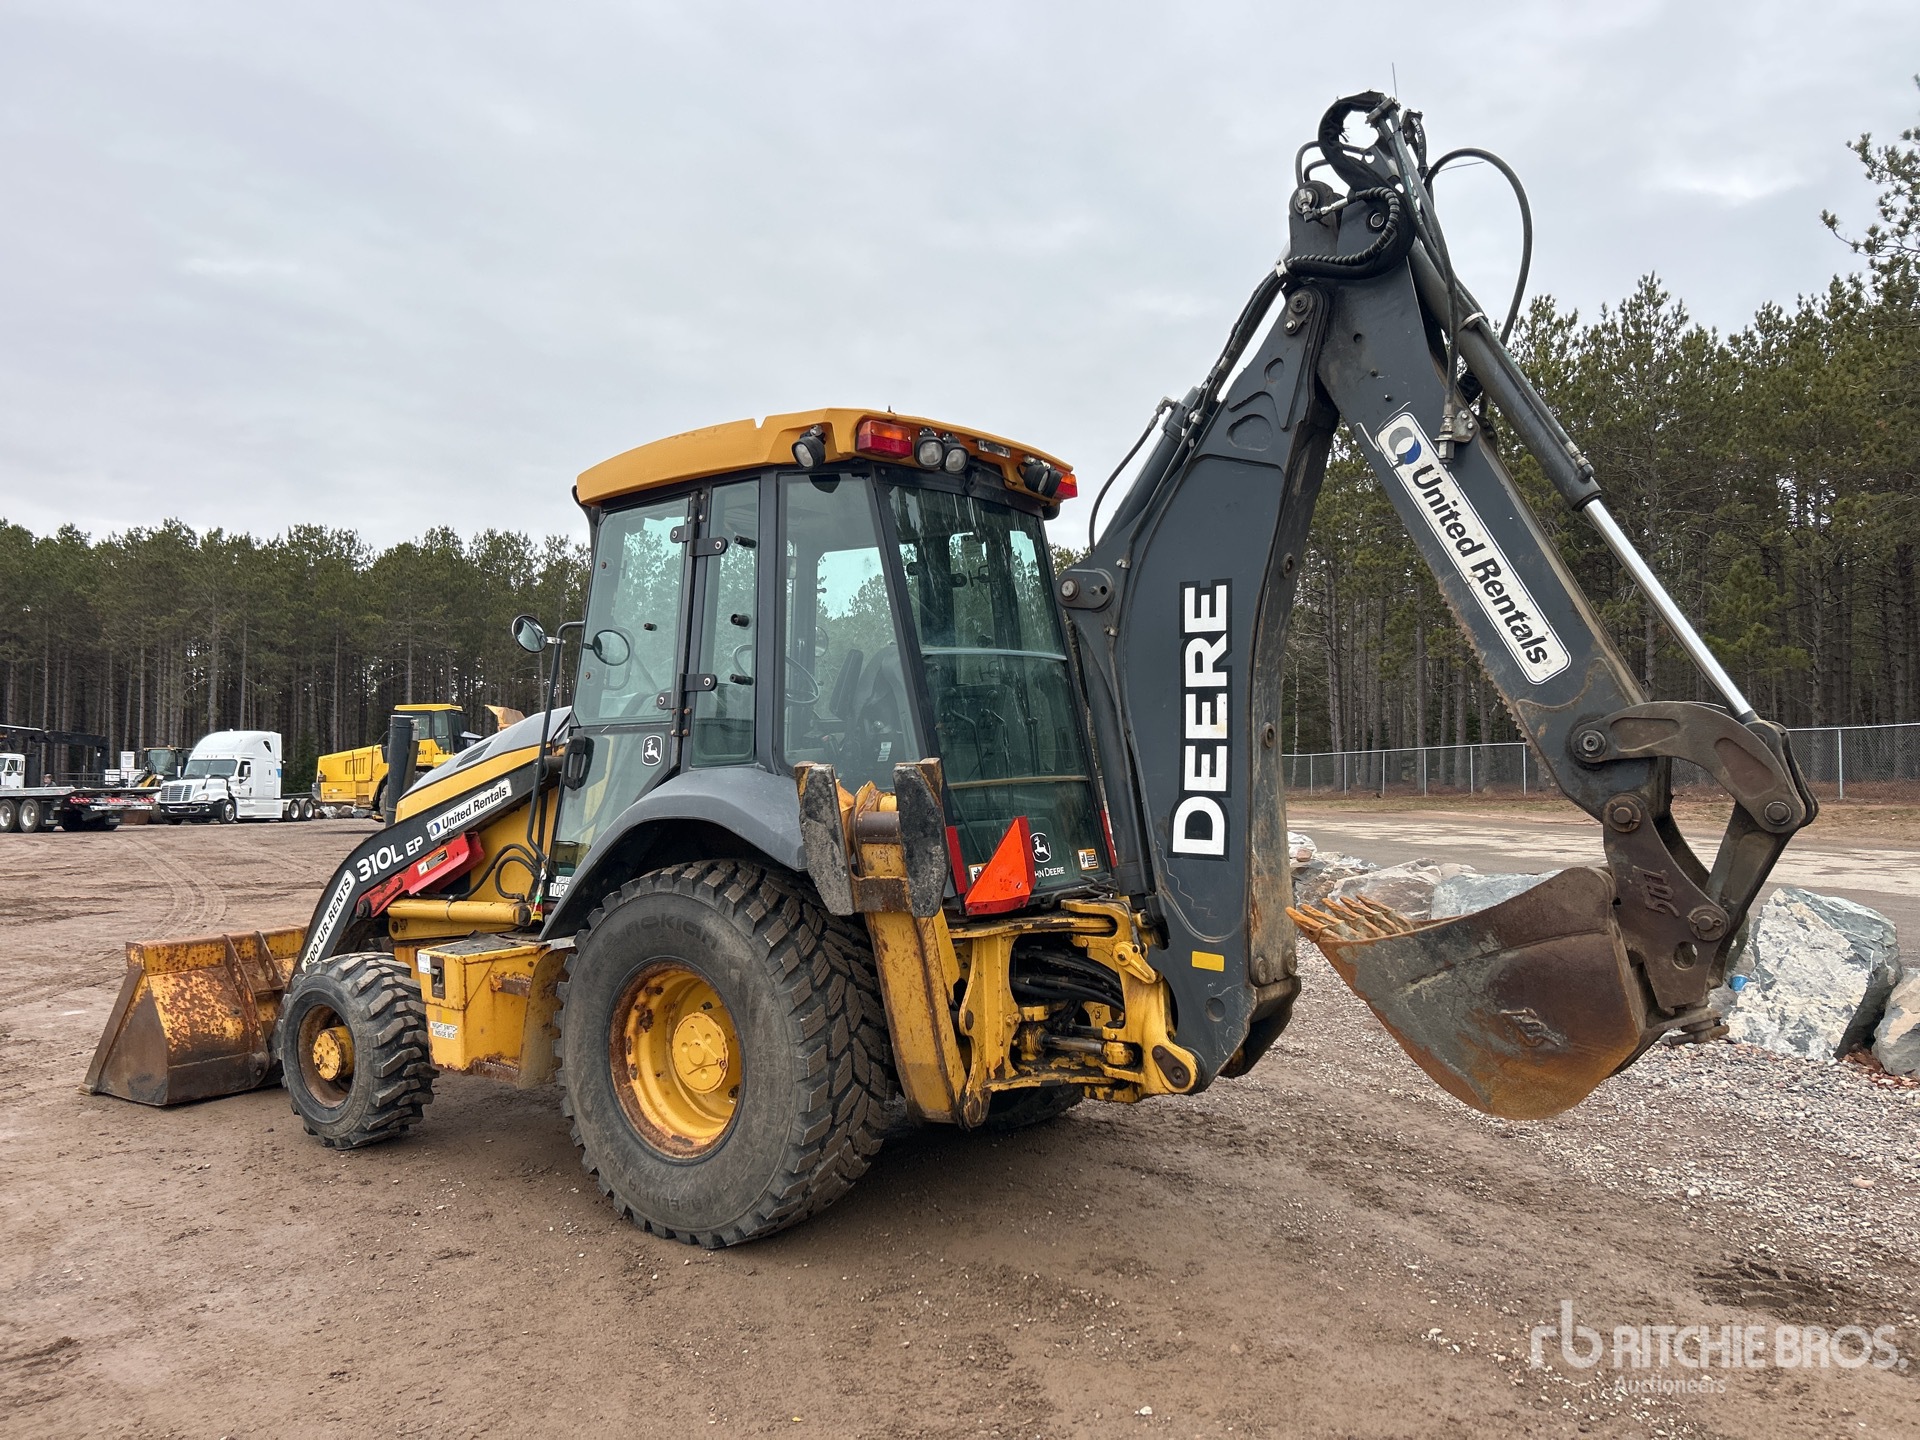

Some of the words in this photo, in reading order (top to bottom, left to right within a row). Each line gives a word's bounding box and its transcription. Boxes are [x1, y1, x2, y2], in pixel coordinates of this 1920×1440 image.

[1412, 464, 1486, 558] United
[1470, 557, 1548, 665] Rentals
[1172, 584, 1227, 855] DEERE
[442, 804, 472, 830] United
[473, 786, 507, 812] Rentals
[356, 844, 403, 882] 310L
[405, 836, 424, 857] EP
[1035, 869, 1045, 878] HN
[1044, 866, 1065, 877] DEERE
